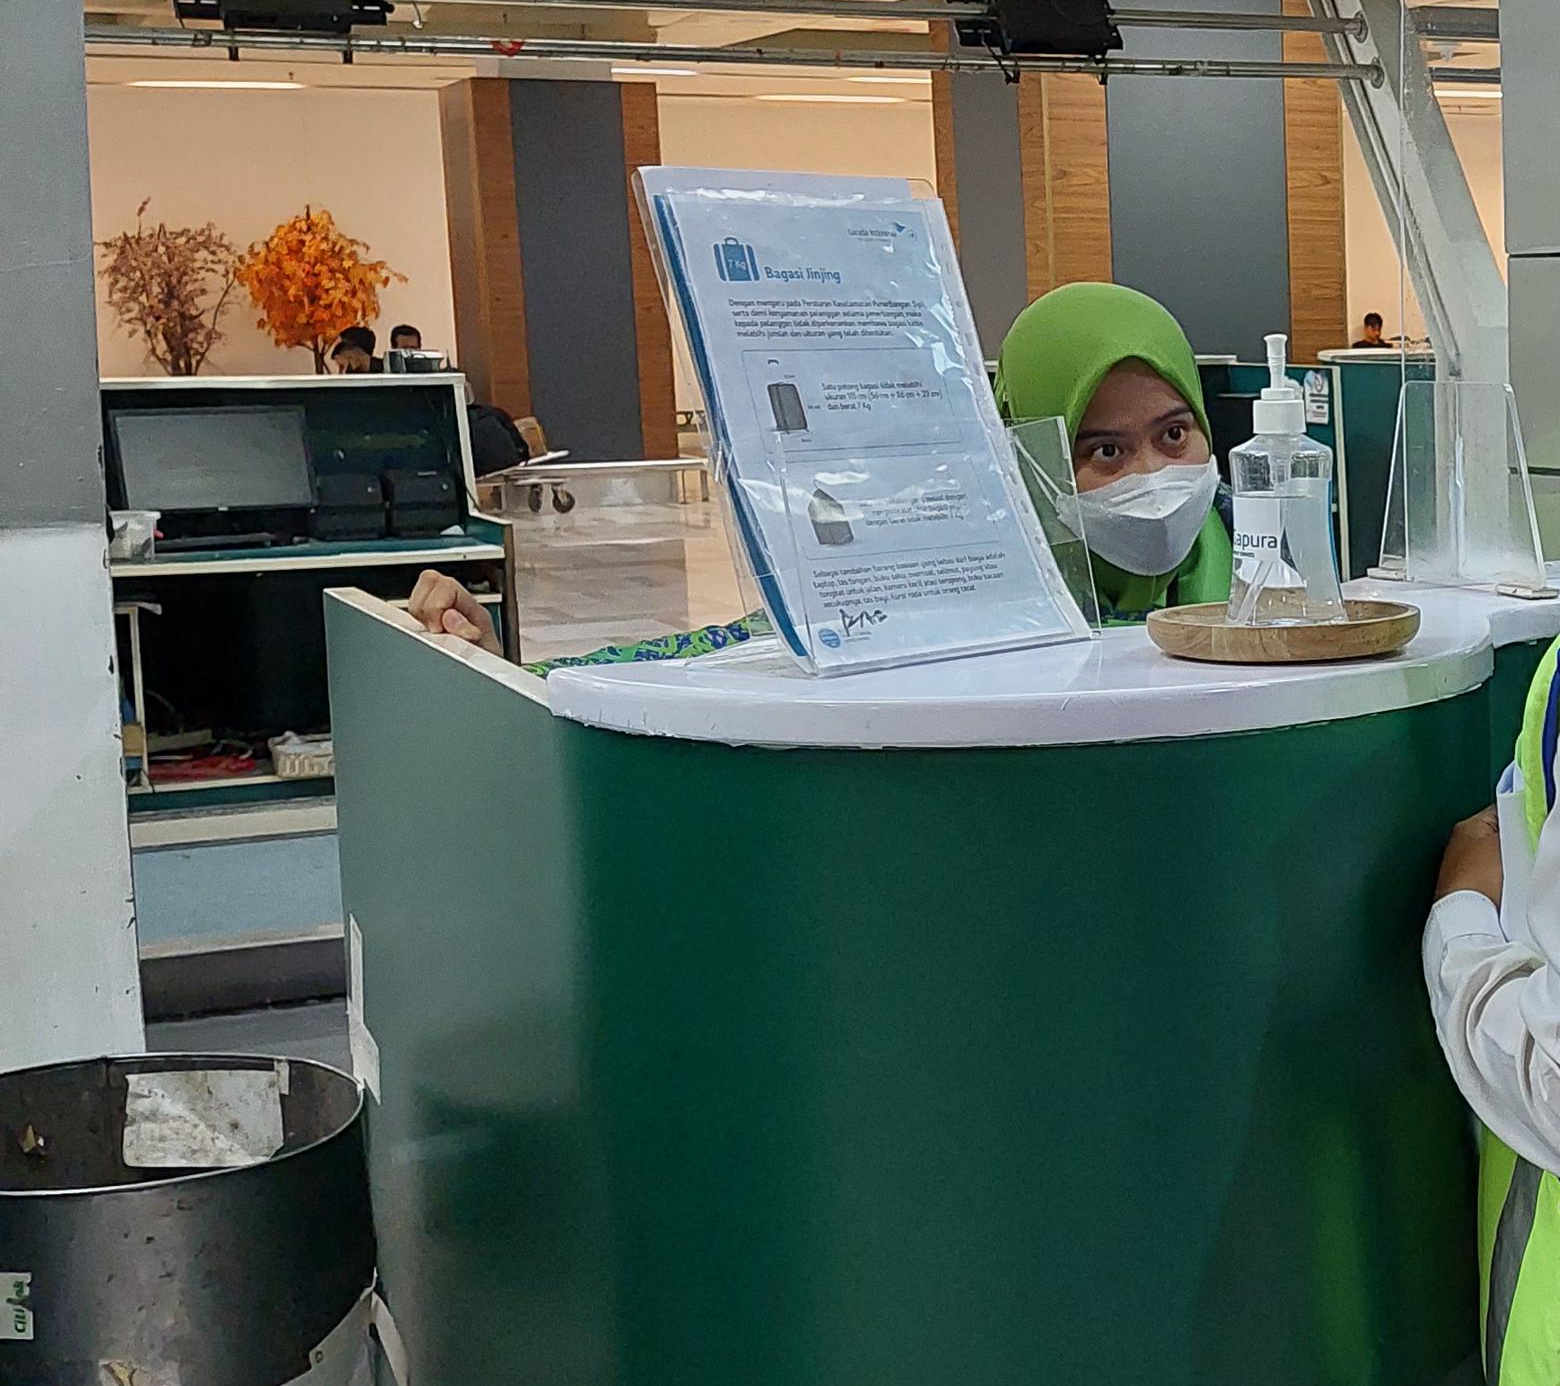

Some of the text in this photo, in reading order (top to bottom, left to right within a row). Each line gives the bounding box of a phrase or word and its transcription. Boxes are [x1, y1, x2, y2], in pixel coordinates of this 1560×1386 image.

[764, 266, 841, 284] Bagasi Jinjing
[1233, 528, 1278, 551] apura
